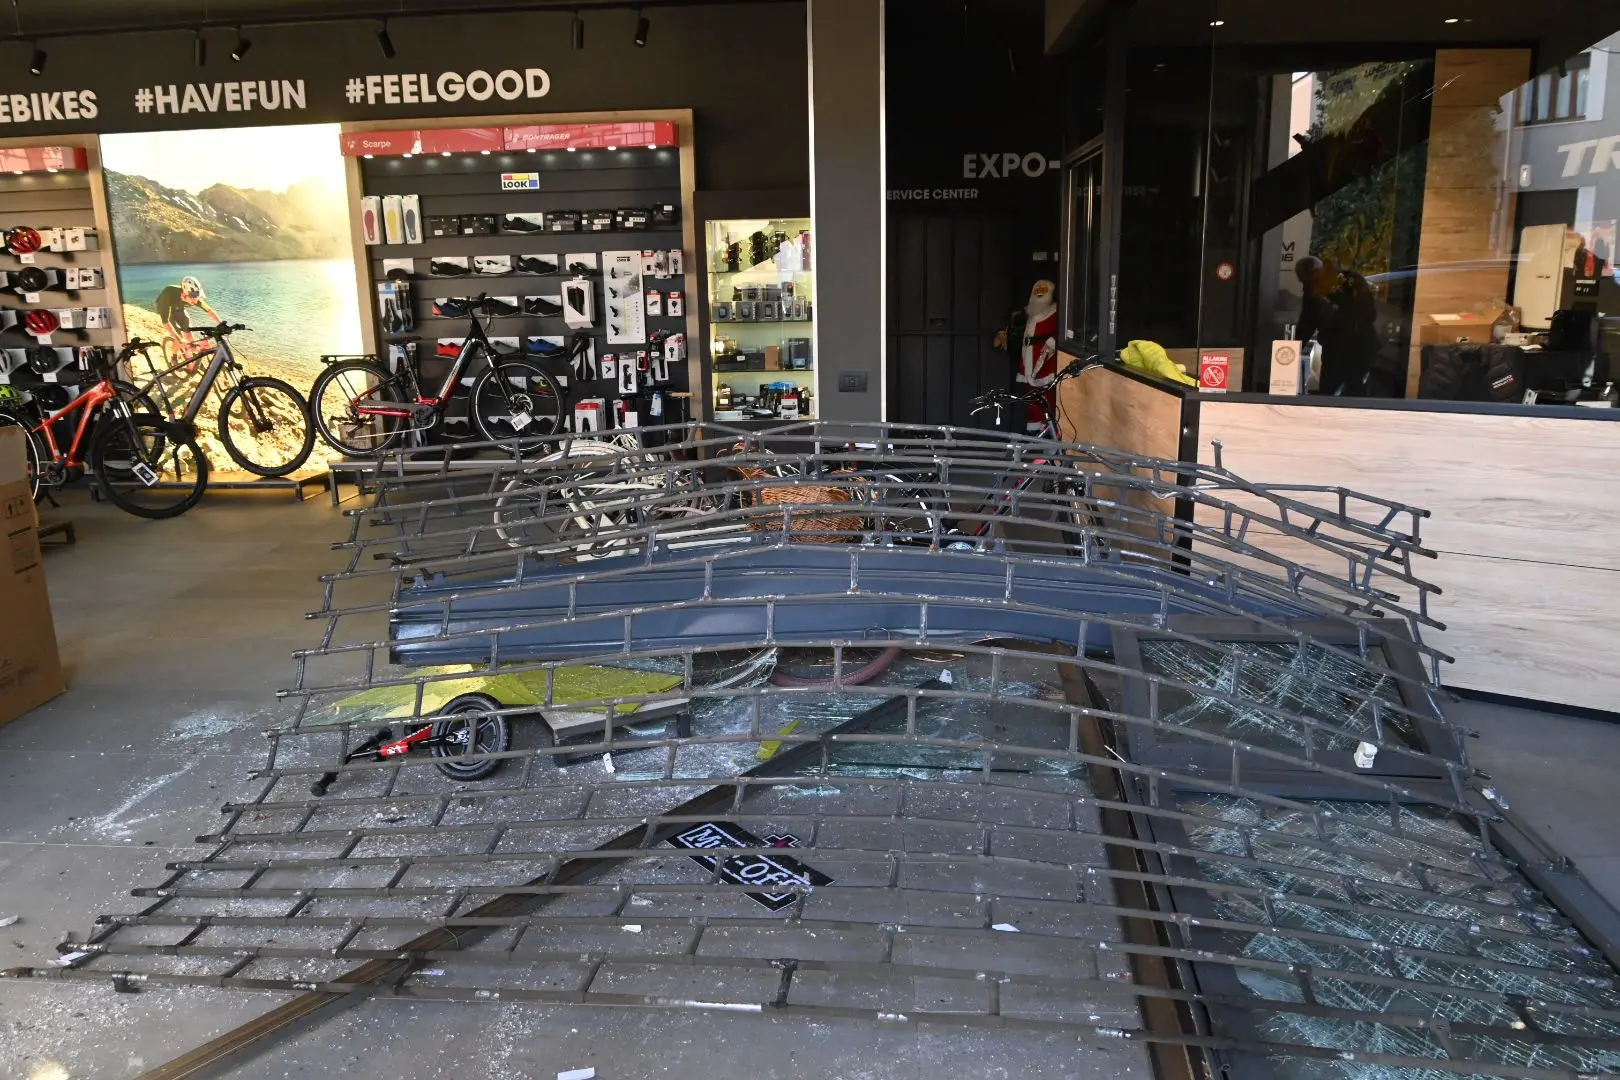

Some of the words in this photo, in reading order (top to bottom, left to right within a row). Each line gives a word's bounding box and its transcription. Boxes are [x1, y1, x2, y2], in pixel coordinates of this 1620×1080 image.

[345, 68, 550, 105] #FEELGOOD
[135, 79, 307, 115] #HAVEFUN
[362, 140, 392, 150] Scarpe
[503, 180, 528, 189] LOOK
[887, 189, 930, 200] ERVICE
[932, 189, 979, 200] CENTER
